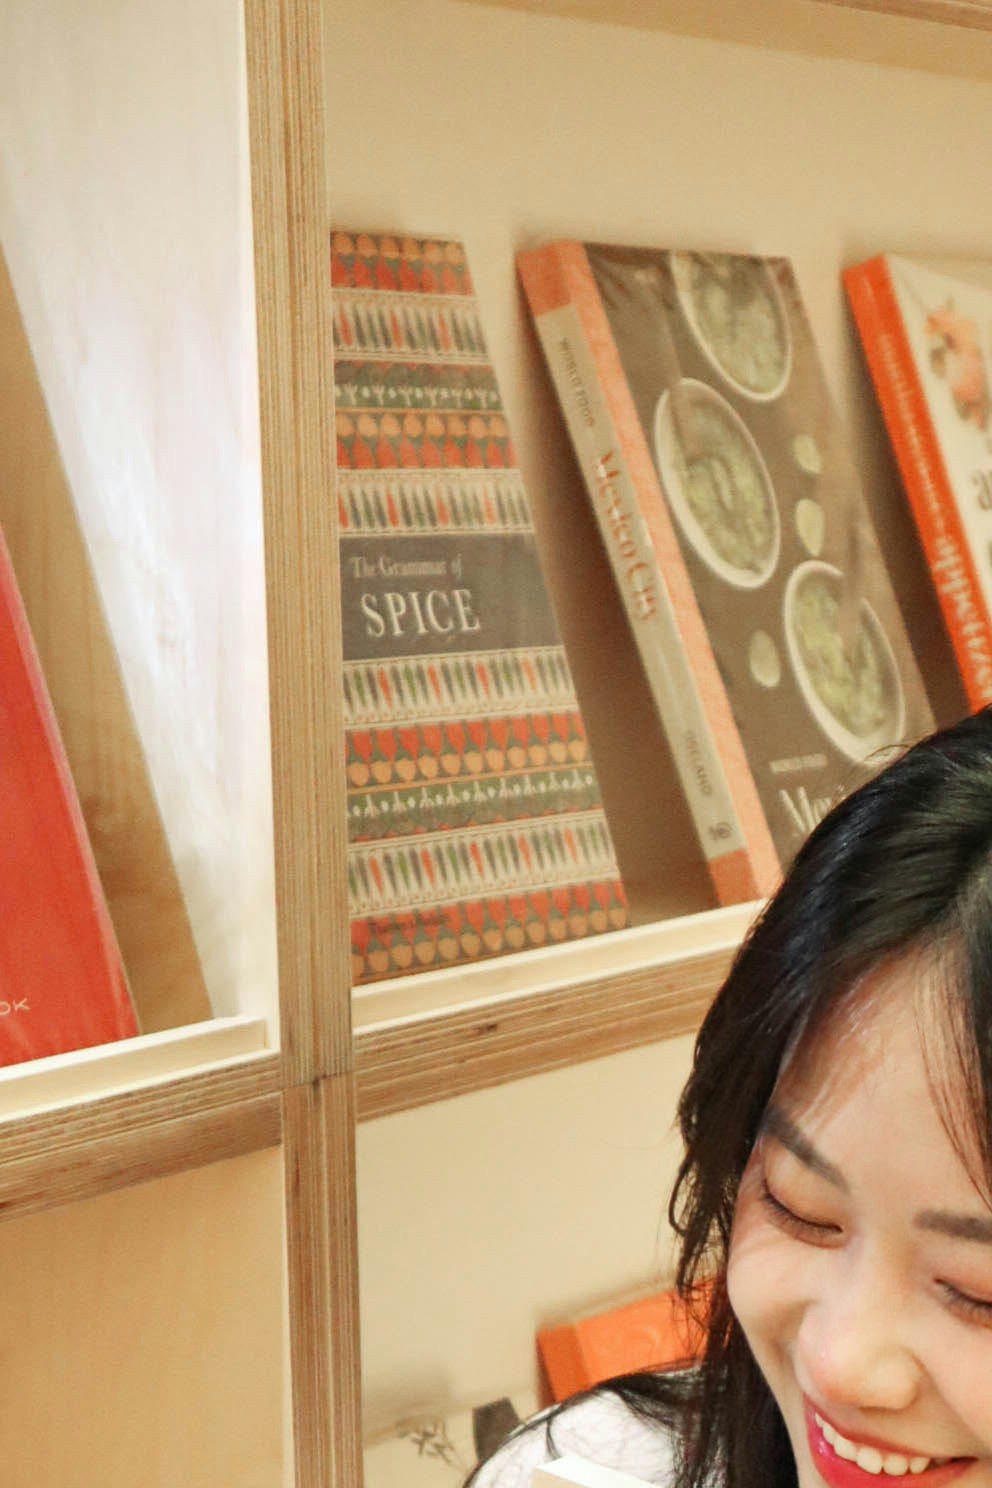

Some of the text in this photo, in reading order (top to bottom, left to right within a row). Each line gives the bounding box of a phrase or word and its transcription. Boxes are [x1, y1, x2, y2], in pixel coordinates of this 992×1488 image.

[594, 450, 638, 559] Mexico
[350, 557, 376, 578] The
[451, 553, 462, 581] of
[360, 590, 480, 638] SPICE
